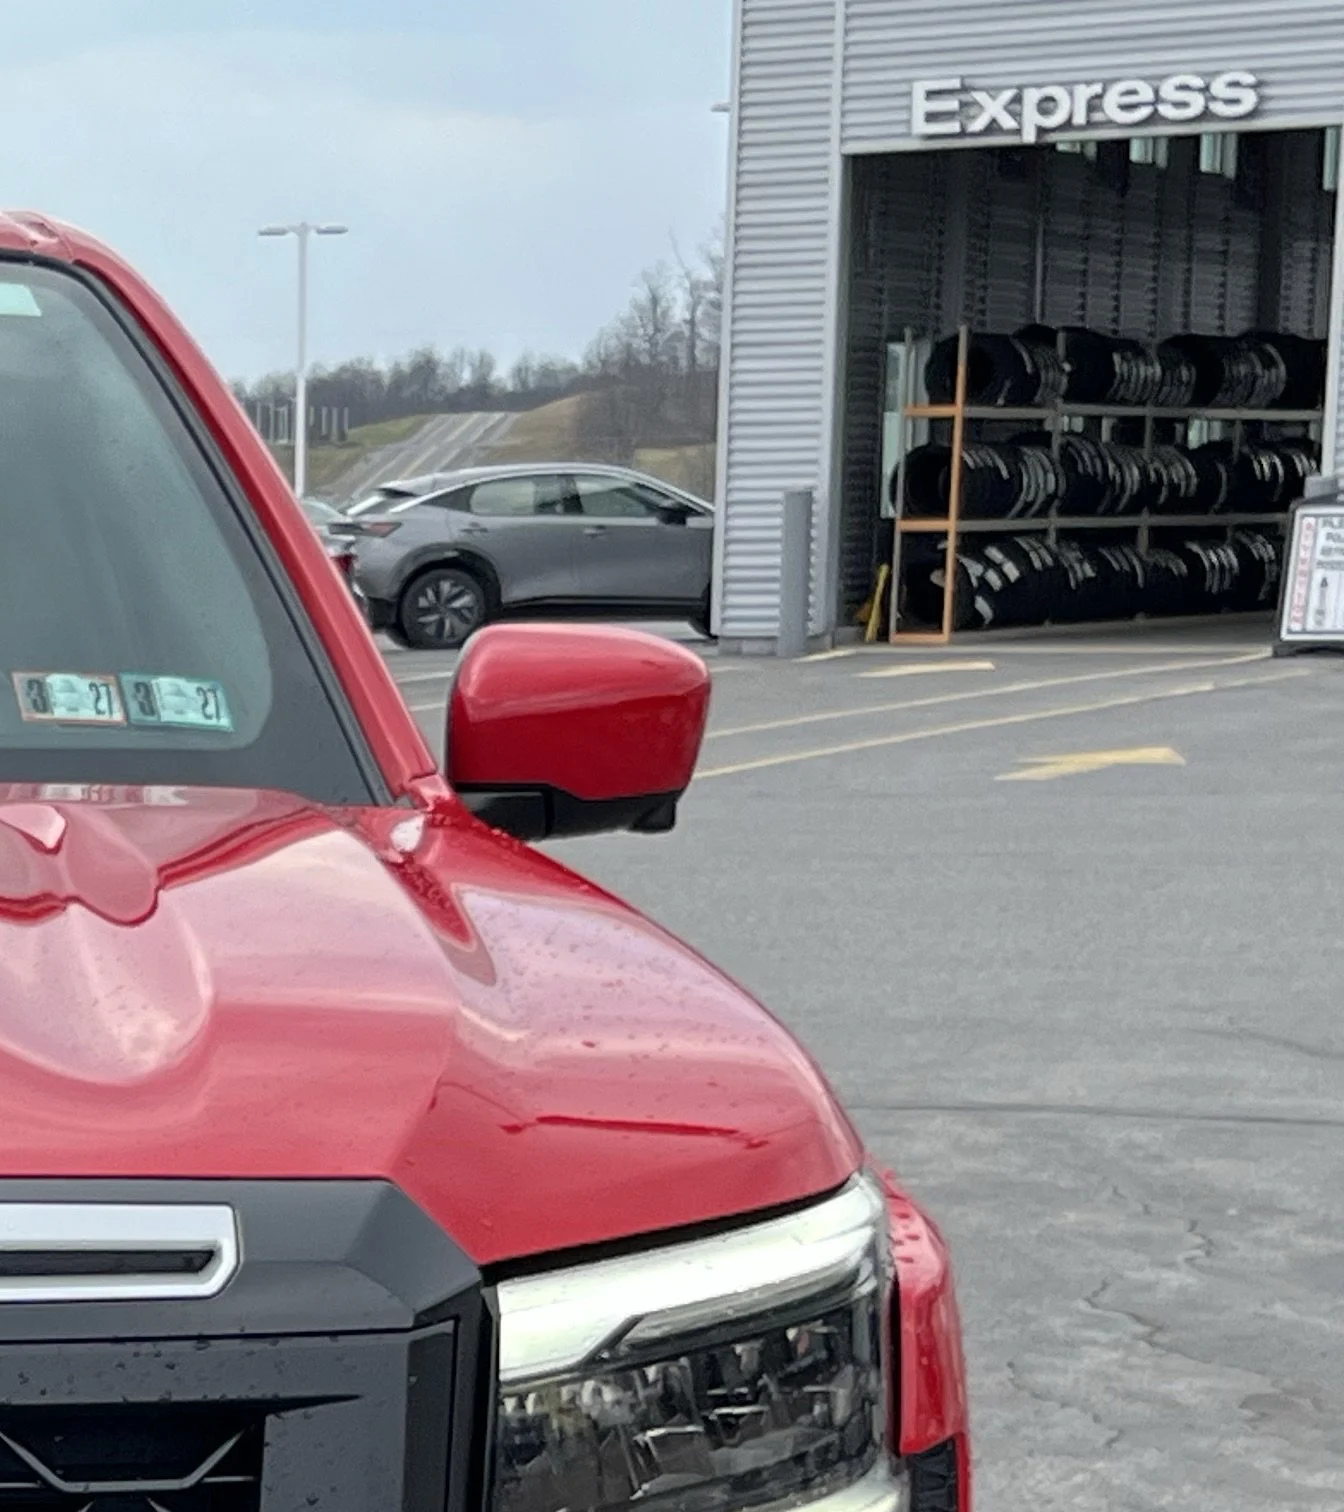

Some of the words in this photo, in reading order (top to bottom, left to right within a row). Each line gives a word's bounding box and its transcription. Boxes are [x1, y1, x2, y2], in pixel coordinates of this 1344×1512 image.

[912, 70, 1260, 143] Express
[26, 679, 48, 713] 3
[88, 682, 114, 717] 27
[134, 681, 156, 716] 3
[196, 686, 221, 722] 27
